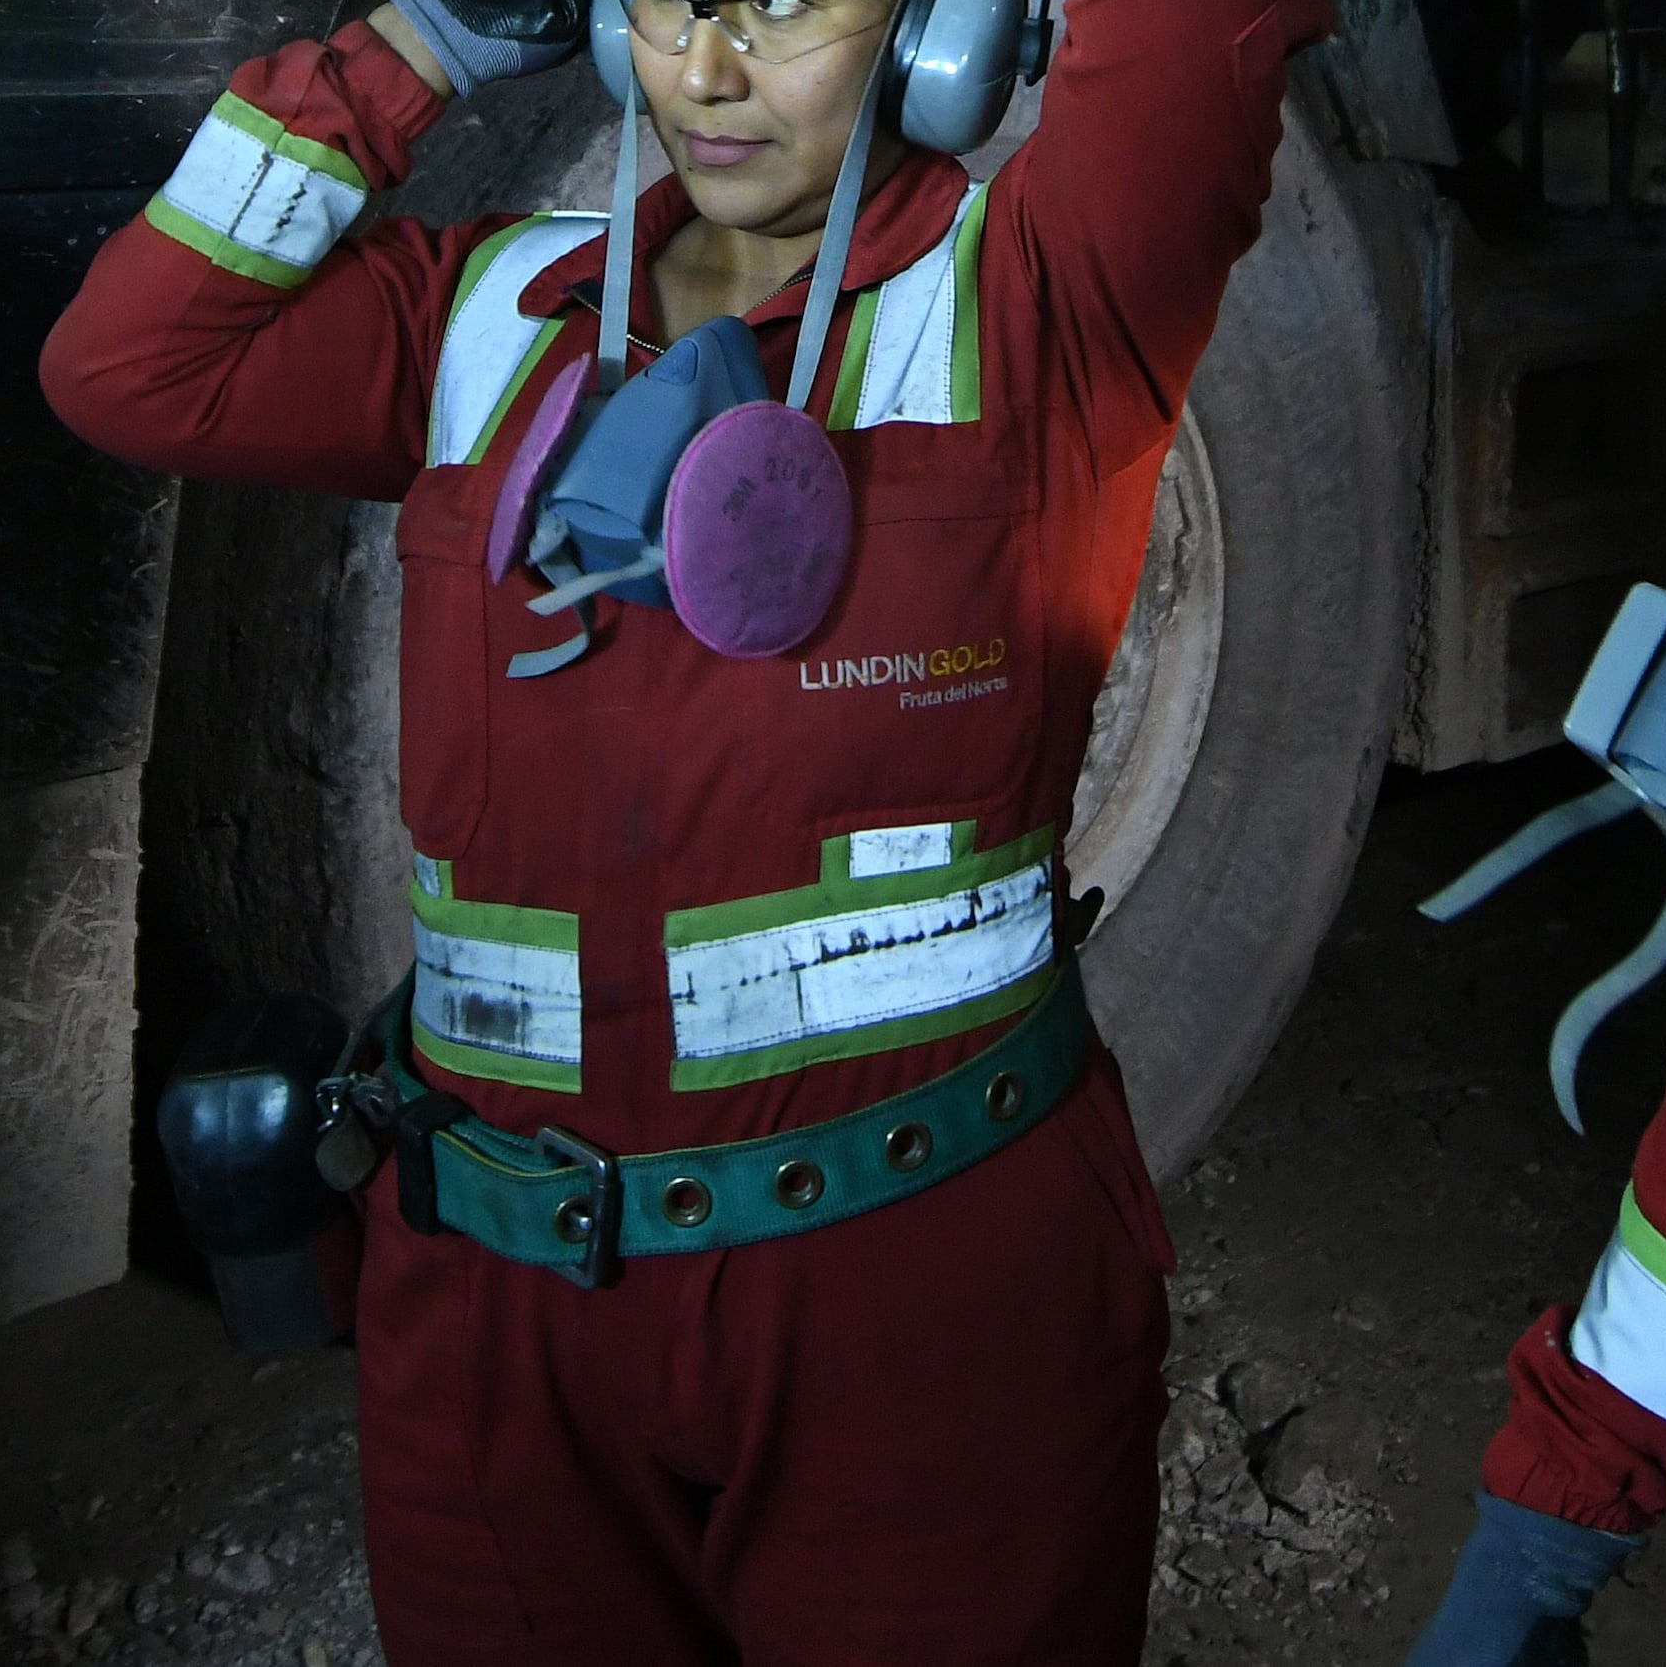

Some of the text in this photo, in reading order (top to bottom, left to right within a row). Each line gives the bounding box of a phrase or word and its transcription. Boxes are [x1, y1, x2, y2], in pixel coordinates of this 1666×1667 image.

[799, 638, 1005, 690] LUNDIN GOLD
[899, 690, 943, 711] Fruta
[944, 683, 967, 703] del
